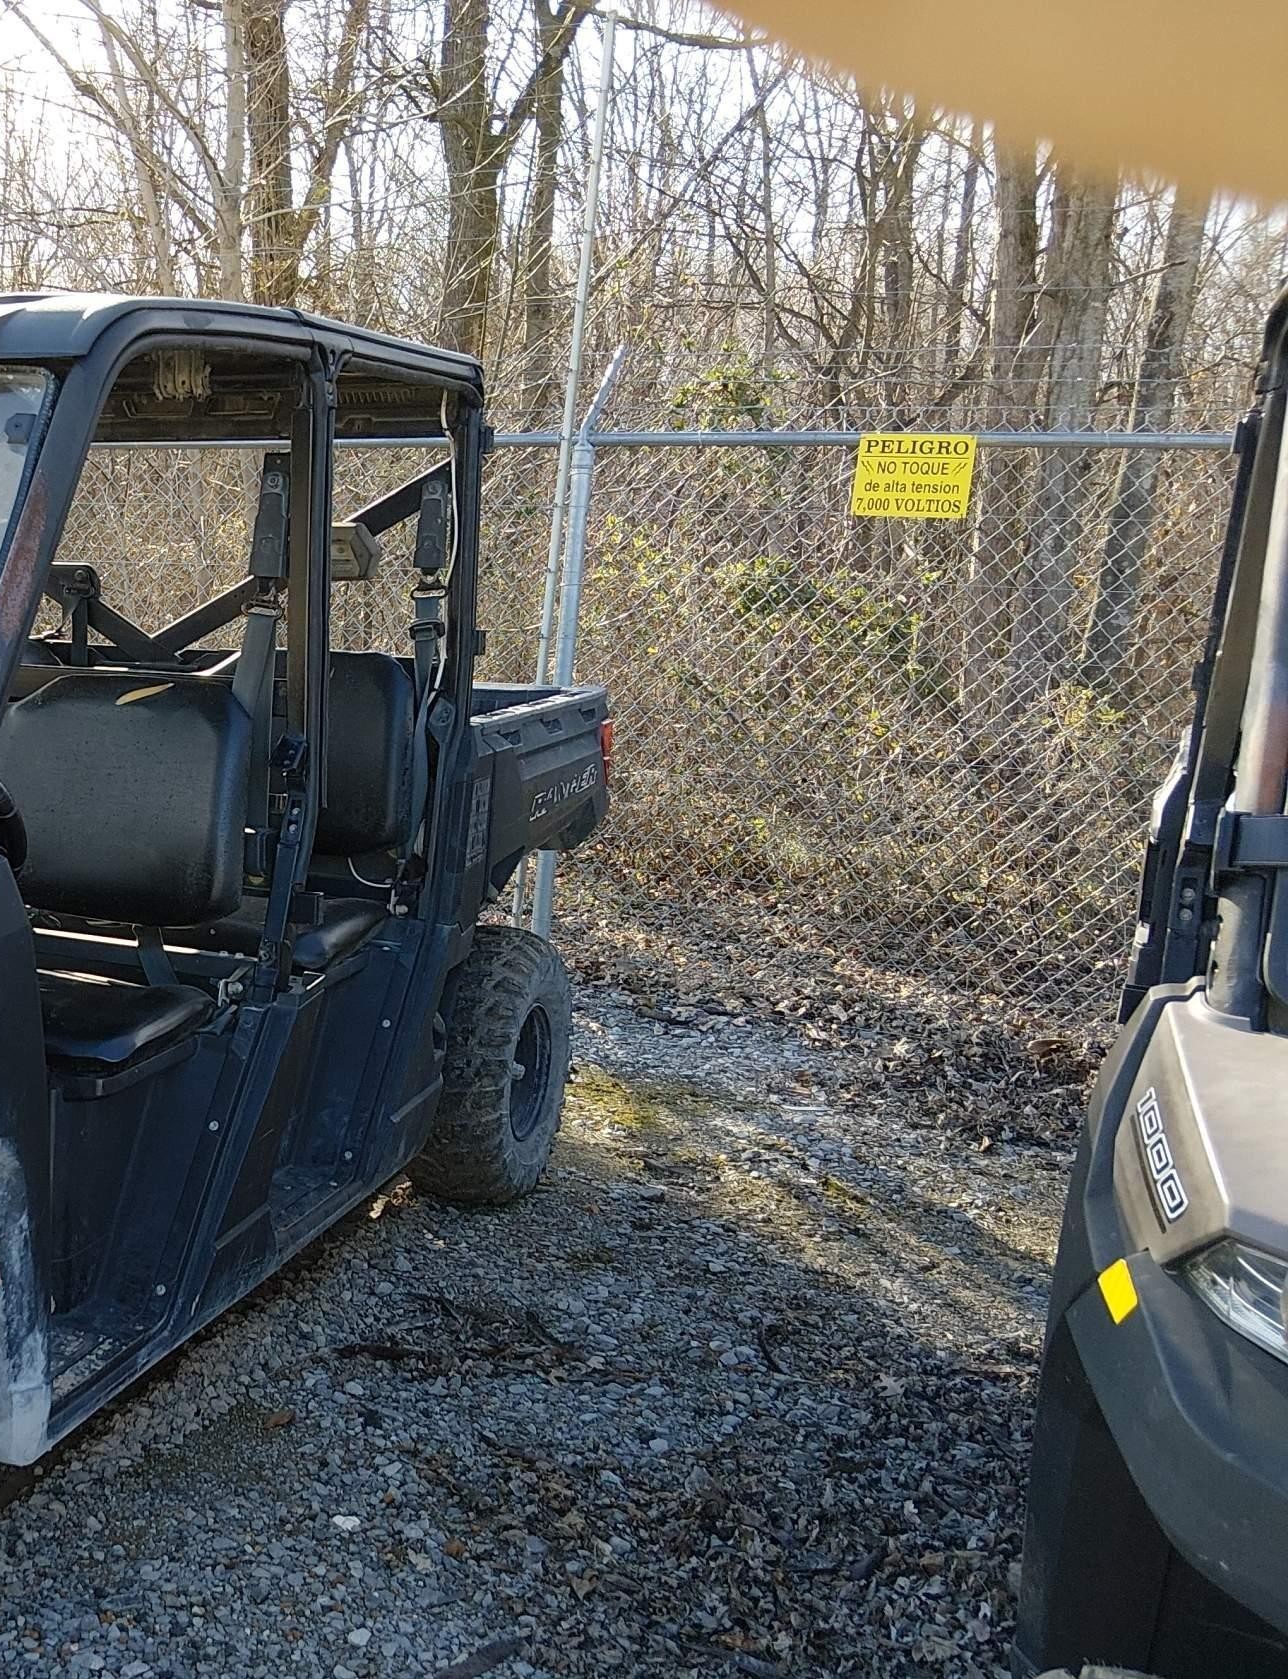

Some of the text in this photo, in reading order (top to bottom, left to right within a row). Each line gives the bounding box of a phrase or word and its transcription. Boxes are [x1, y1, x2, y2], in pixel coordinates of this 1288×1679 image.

[865, 440, 969, 456] PELIGRO
[877, 461, 951, 475] NO TOQUE
[864, 479, 960, 494] de alta tension
[856, 498, 962, 514] 7,000 VOLTIOS
[1136, 1086, 1189, 1220] 1000
